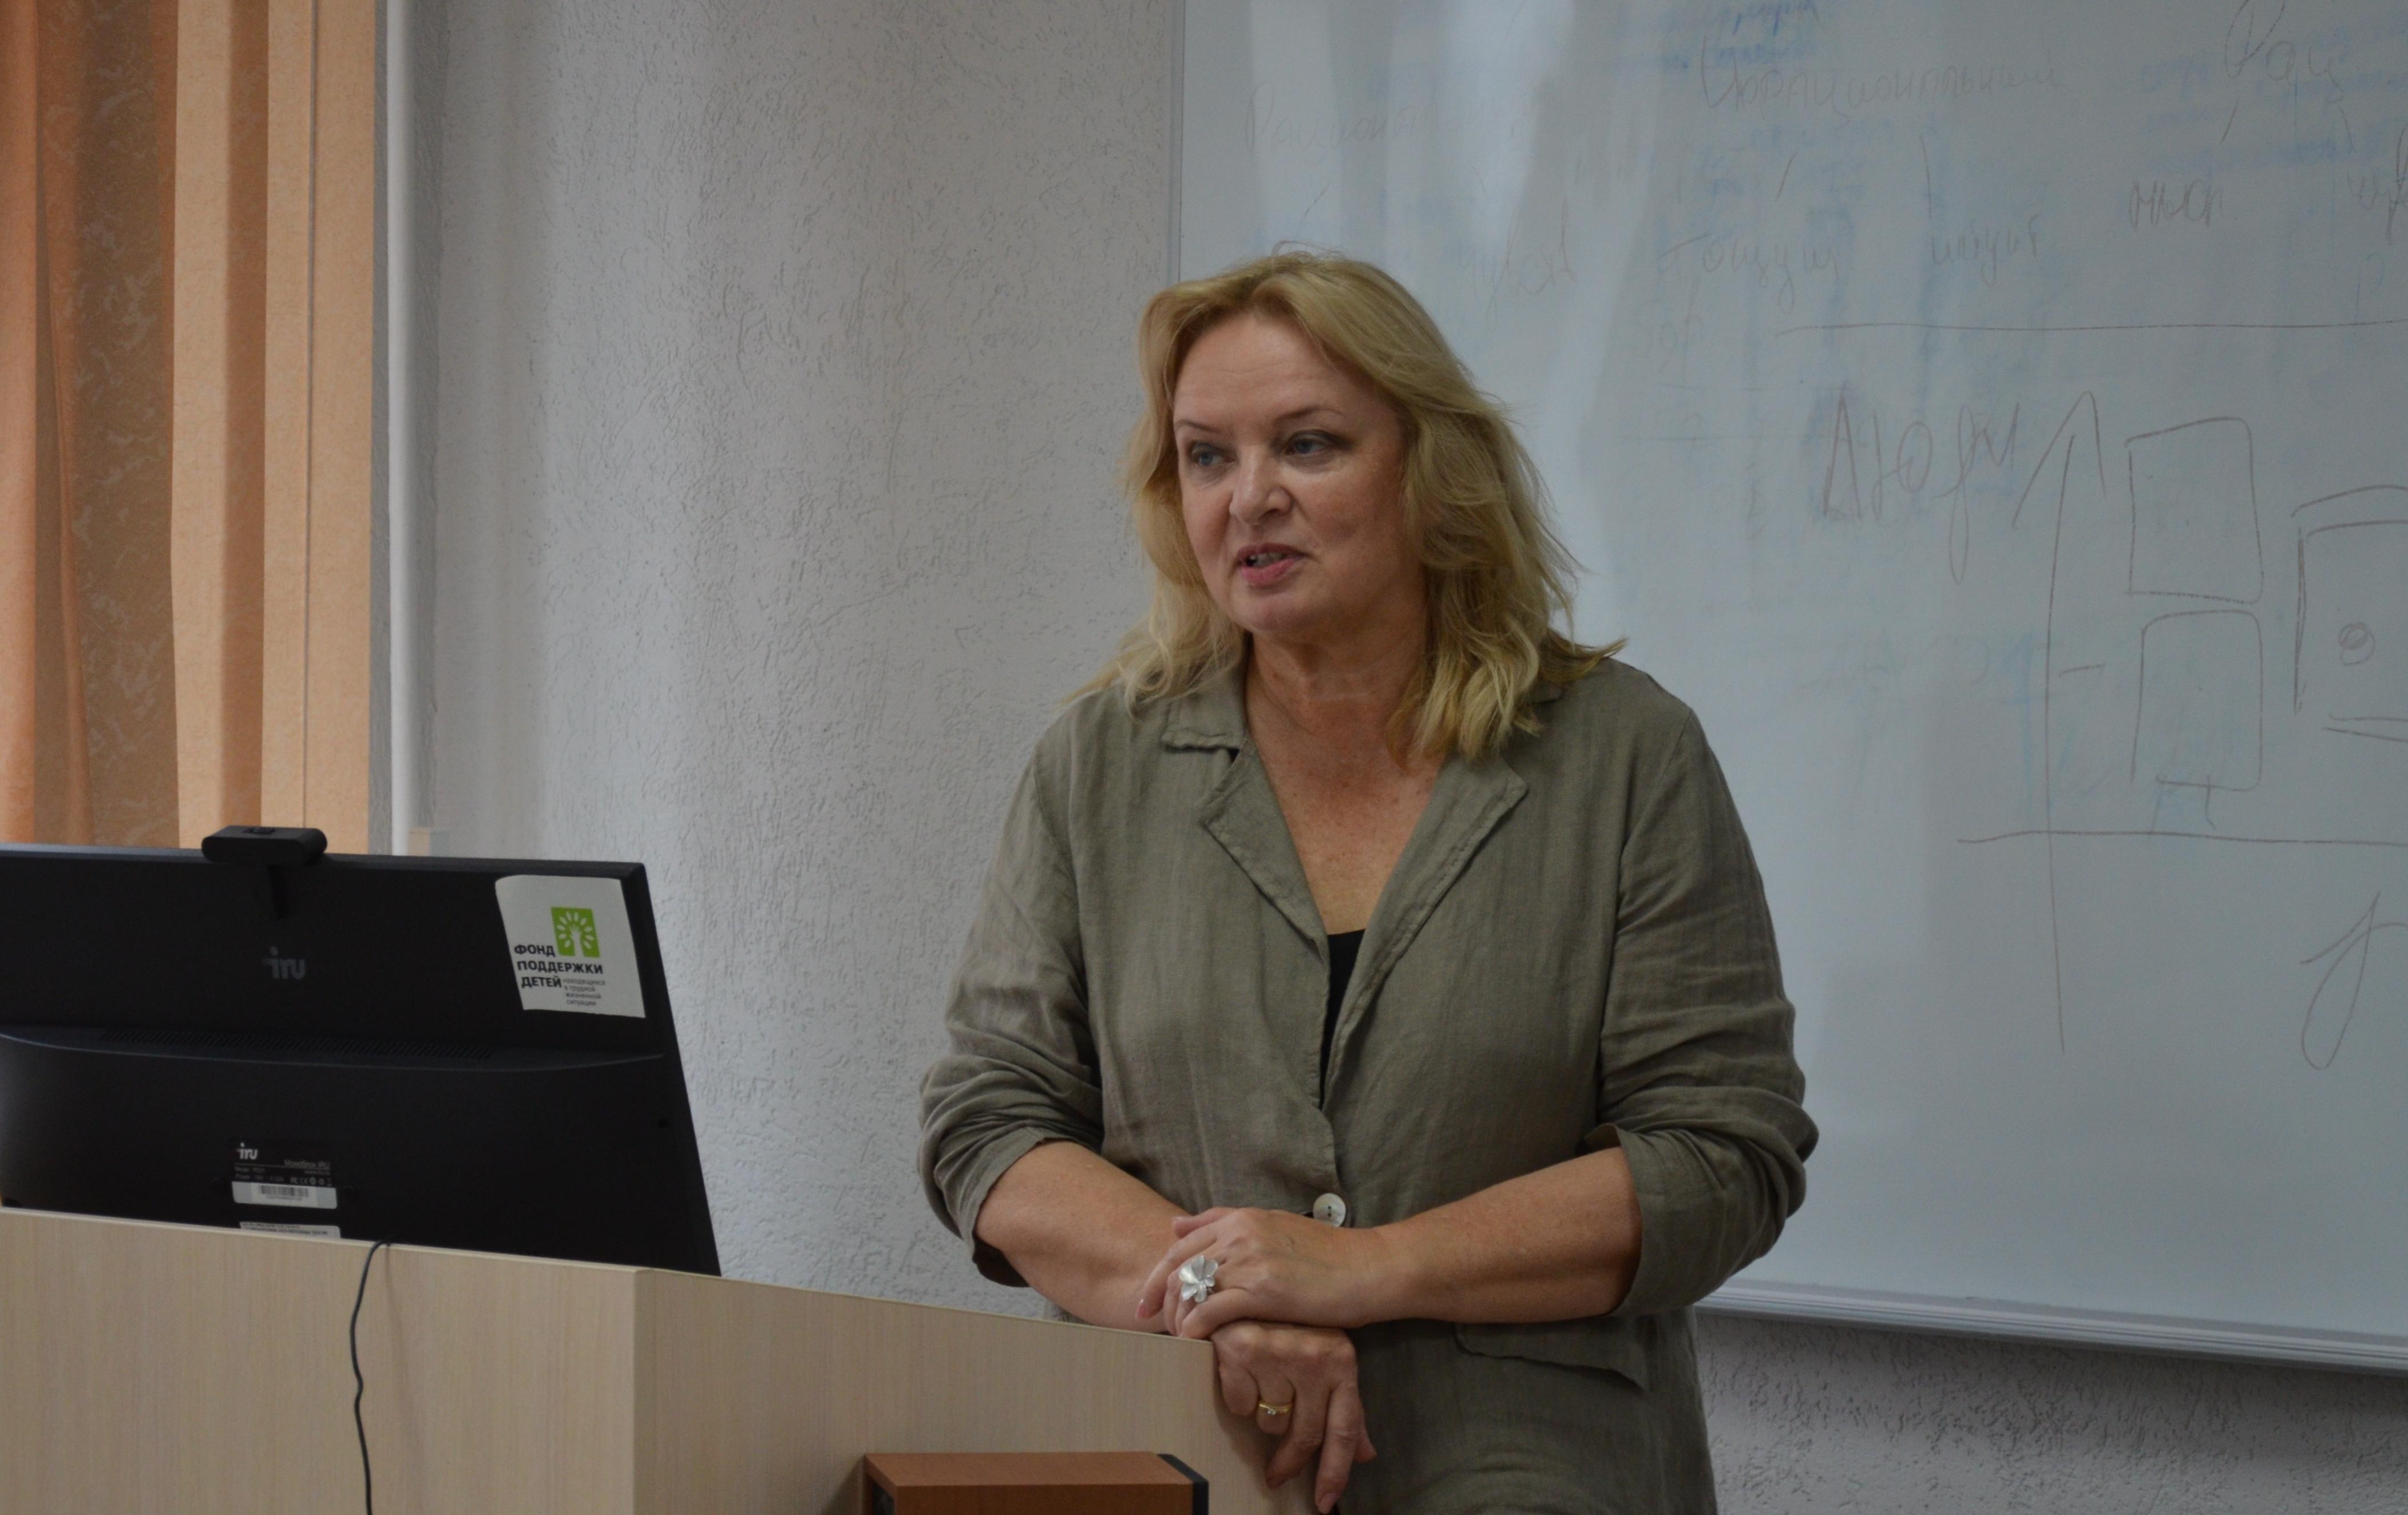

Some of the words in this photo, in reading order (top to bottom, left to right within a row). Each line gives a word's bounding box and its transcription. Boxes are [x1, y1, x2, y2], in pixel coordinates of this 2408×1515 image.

[514, 945, 556, 957] ФОНД
[517, 961, 603, 974] ПОДДЕРЖКИ
[521, 975, 562, 989] ДЕТЕЙ
